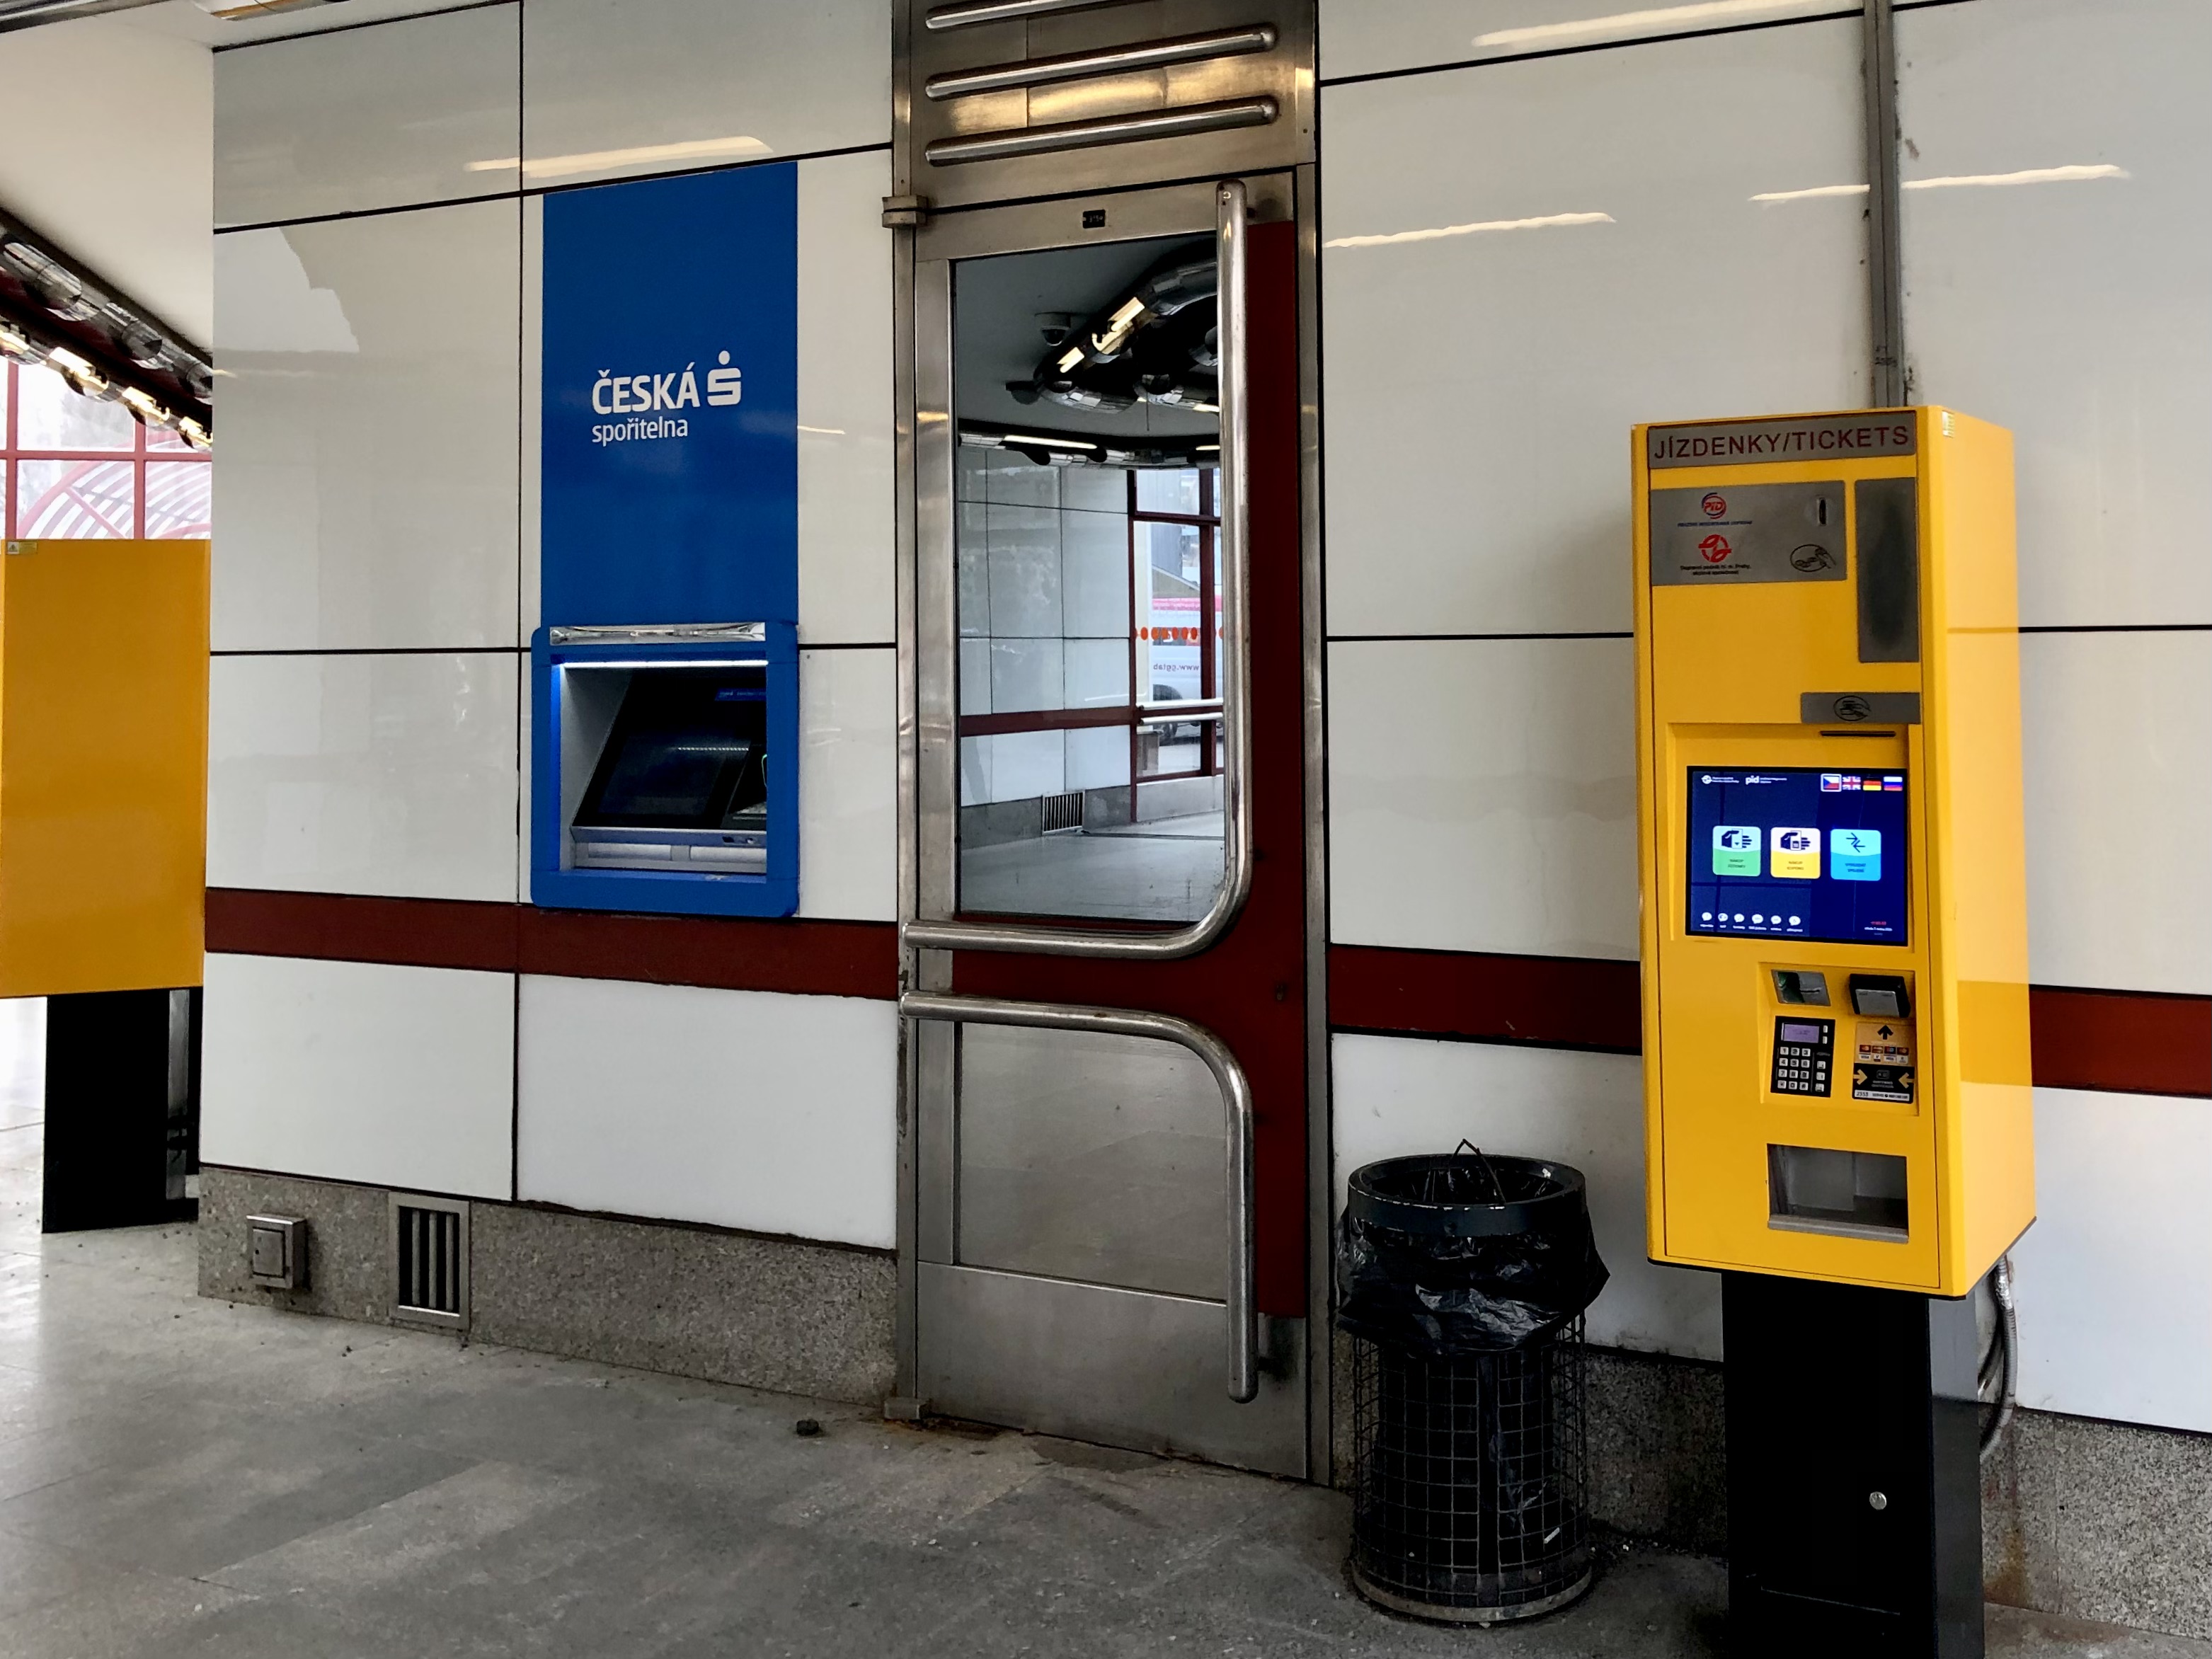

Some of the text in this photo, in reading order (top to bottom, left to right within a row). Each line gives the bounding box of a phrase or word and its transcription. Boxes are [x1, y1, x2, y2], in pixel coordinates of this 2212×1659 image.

[592, 362, 700, 415] ČESKÁ
[592, 416, 688, 447] spořitelna
[1654, 425, 1909, 459] JÍZDENKY/TICKETS
[1745, 775, 1760, 785] pid
